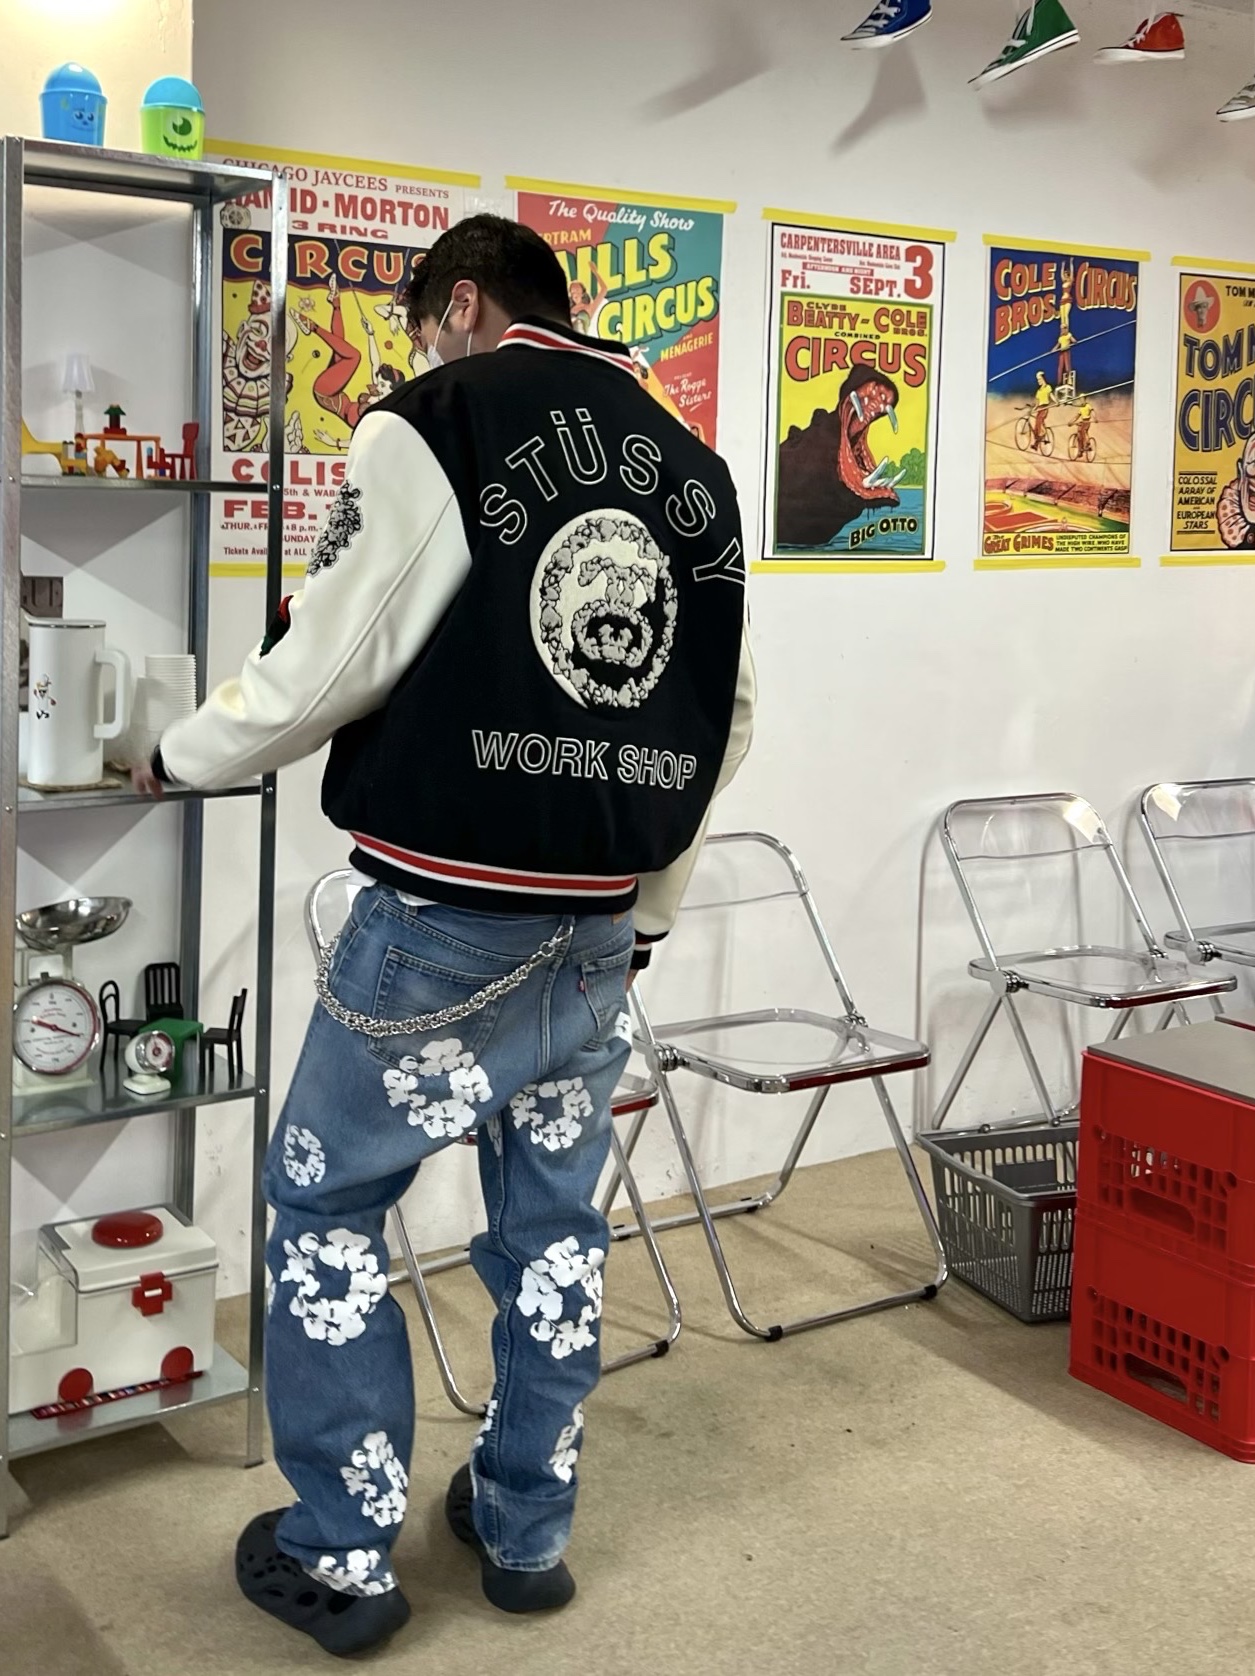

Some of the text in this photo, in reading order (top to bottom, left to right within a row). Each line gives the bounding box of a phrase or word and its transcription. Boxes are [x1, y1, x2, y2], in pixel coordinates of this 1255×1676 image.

[311, 169, 388, 192] JAYCEES
[395, 184, 450, 199] PRESENTS
[225, 187, 449, 231] AID MORTON
[549, 200, 695, 232] The Quality Show
[291, 220, 389, 240] 3 RING
[230, 233, 427, 285] CRCU
[780, 232, 875, 258] CARPENTERSVILLE
[876, 243, 901, 261] AREA
[780, 269, 902, 298] Fri. SEPT.
[904, 245, 934, 300] 3
[994, 258, 1137, 312] COLE CIRCUS
[1225, 285, 1246, 298] TOM
[598, 276, 719, 346] CIRCUS
[806, 302, 847, 312] CLYDE
[994, 293, 1061, 345] BROS.
[660, 331, 714, 362] MENAGERIE
[834, 331, 881, 340] COMBINED
[784, 335, 928, 388] CIRCUS
[1183, 333, 1244, 382] TOM
[664, 383, 680, 396] The
[678, 391, 712, 408] Sisters
[1178, 376, 1255, 453] CIRC
[1178, 476, 1218, 485] COLOSSAL
[1178, 487, 1217, 495] ARRAY OF
[1176, 511, 1216, 520] EUROPEAN
[1177, 496, 1216, 506] AMERICAN
[850, 517, 918, 549] BIG OTTO
[1183, 520, 1209, 530] STARS
[224, 547, 249, 556] Tickets
[984, 533, 1055, 554] GREAT GRIMES
[471, 729, 698, 791] WORK SHOP
